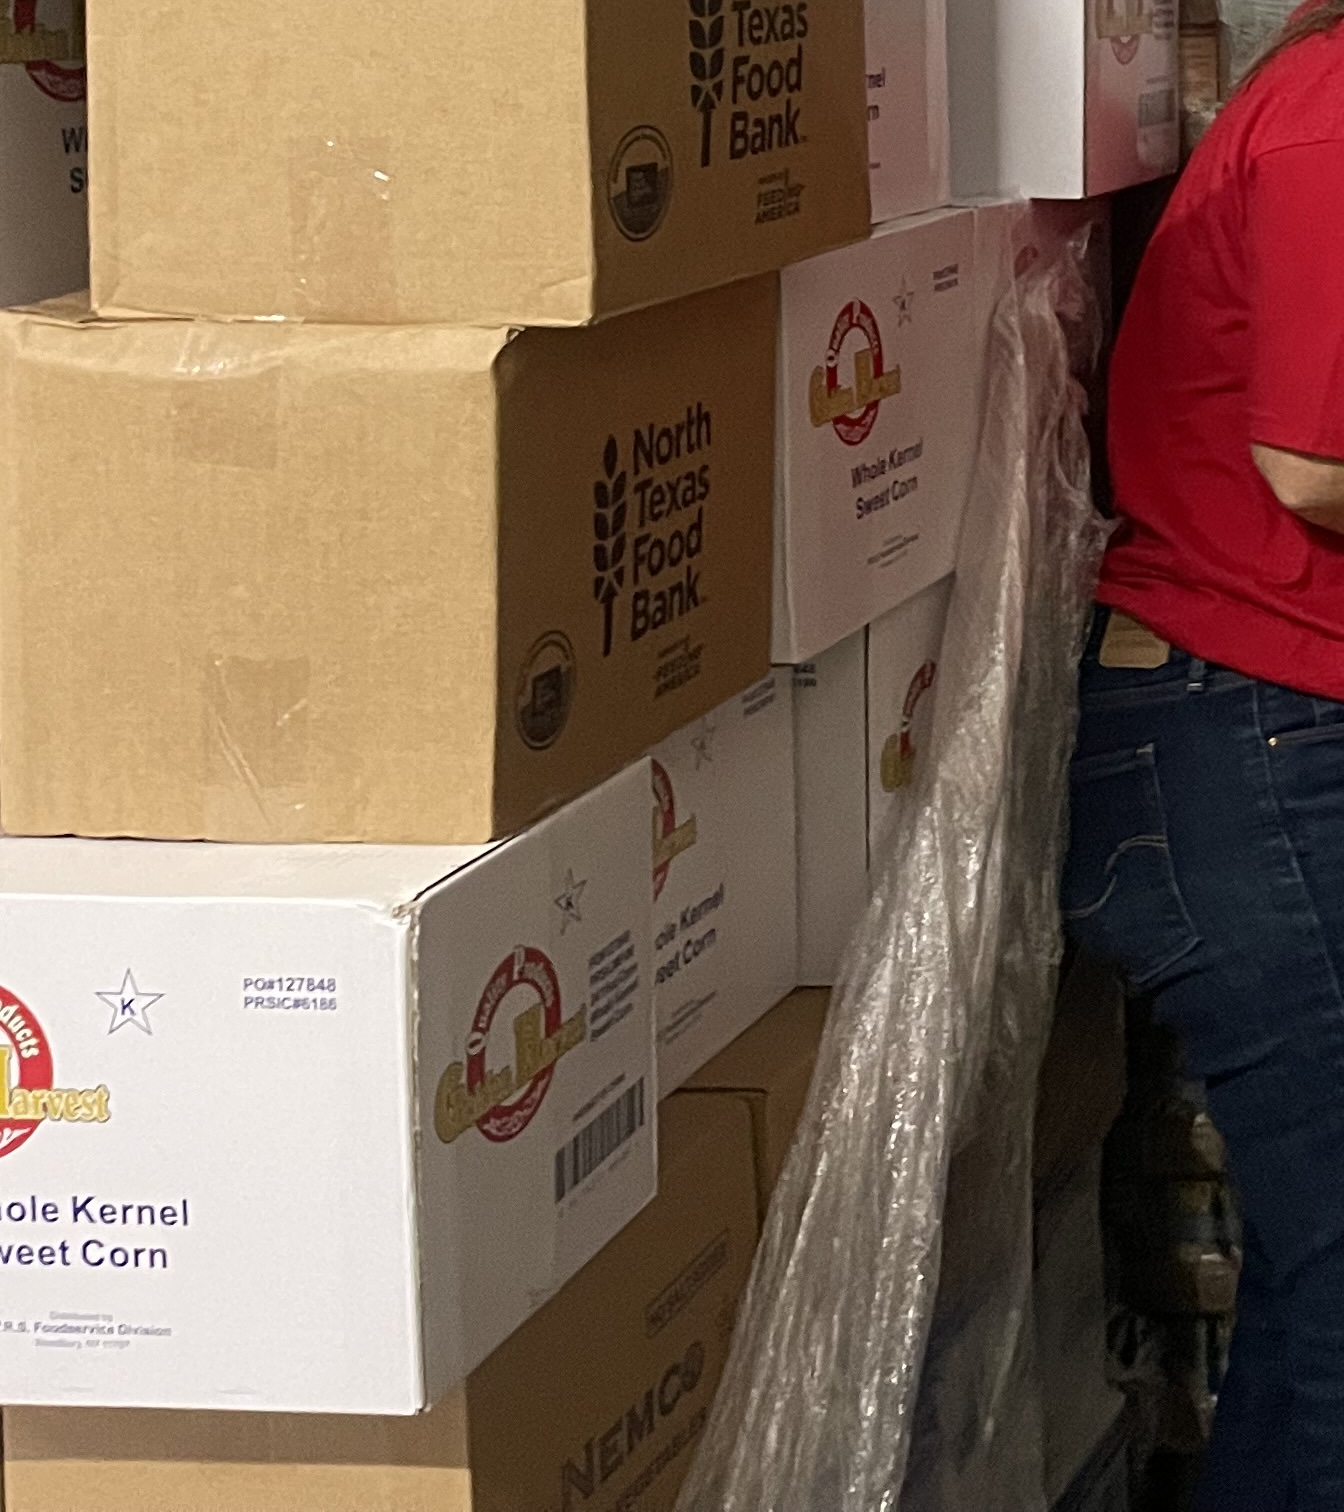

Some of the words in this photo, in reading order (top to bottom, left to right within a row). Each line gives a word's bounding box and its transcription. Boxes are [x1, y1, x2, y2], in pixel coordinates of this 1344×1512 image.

[731, 0, 809, 48] Texas
[731, 43, 803, 105] Food
[728, 97, 801, 161] Bank
[632, 401, 712, 477] North
[850, 452, 888, 490] Whole
[632, 464, 710, 529] Texas
[855, 481, 890, 521] Sweet
[890, 475, 919, 506] Corn
[632, 505, 704, 587] Food
[630, 565, 700, 642] Bank
[682, 927, 718, 963] Corn
[119, 998, 137, 1016] K
[242, 977, 338, 994] PO#127848
[70, 1195, 190, 1228] Kernel
[81, 1238, 170, 1270] Corn
[560, 1340, 706, 1502] NEMCO
